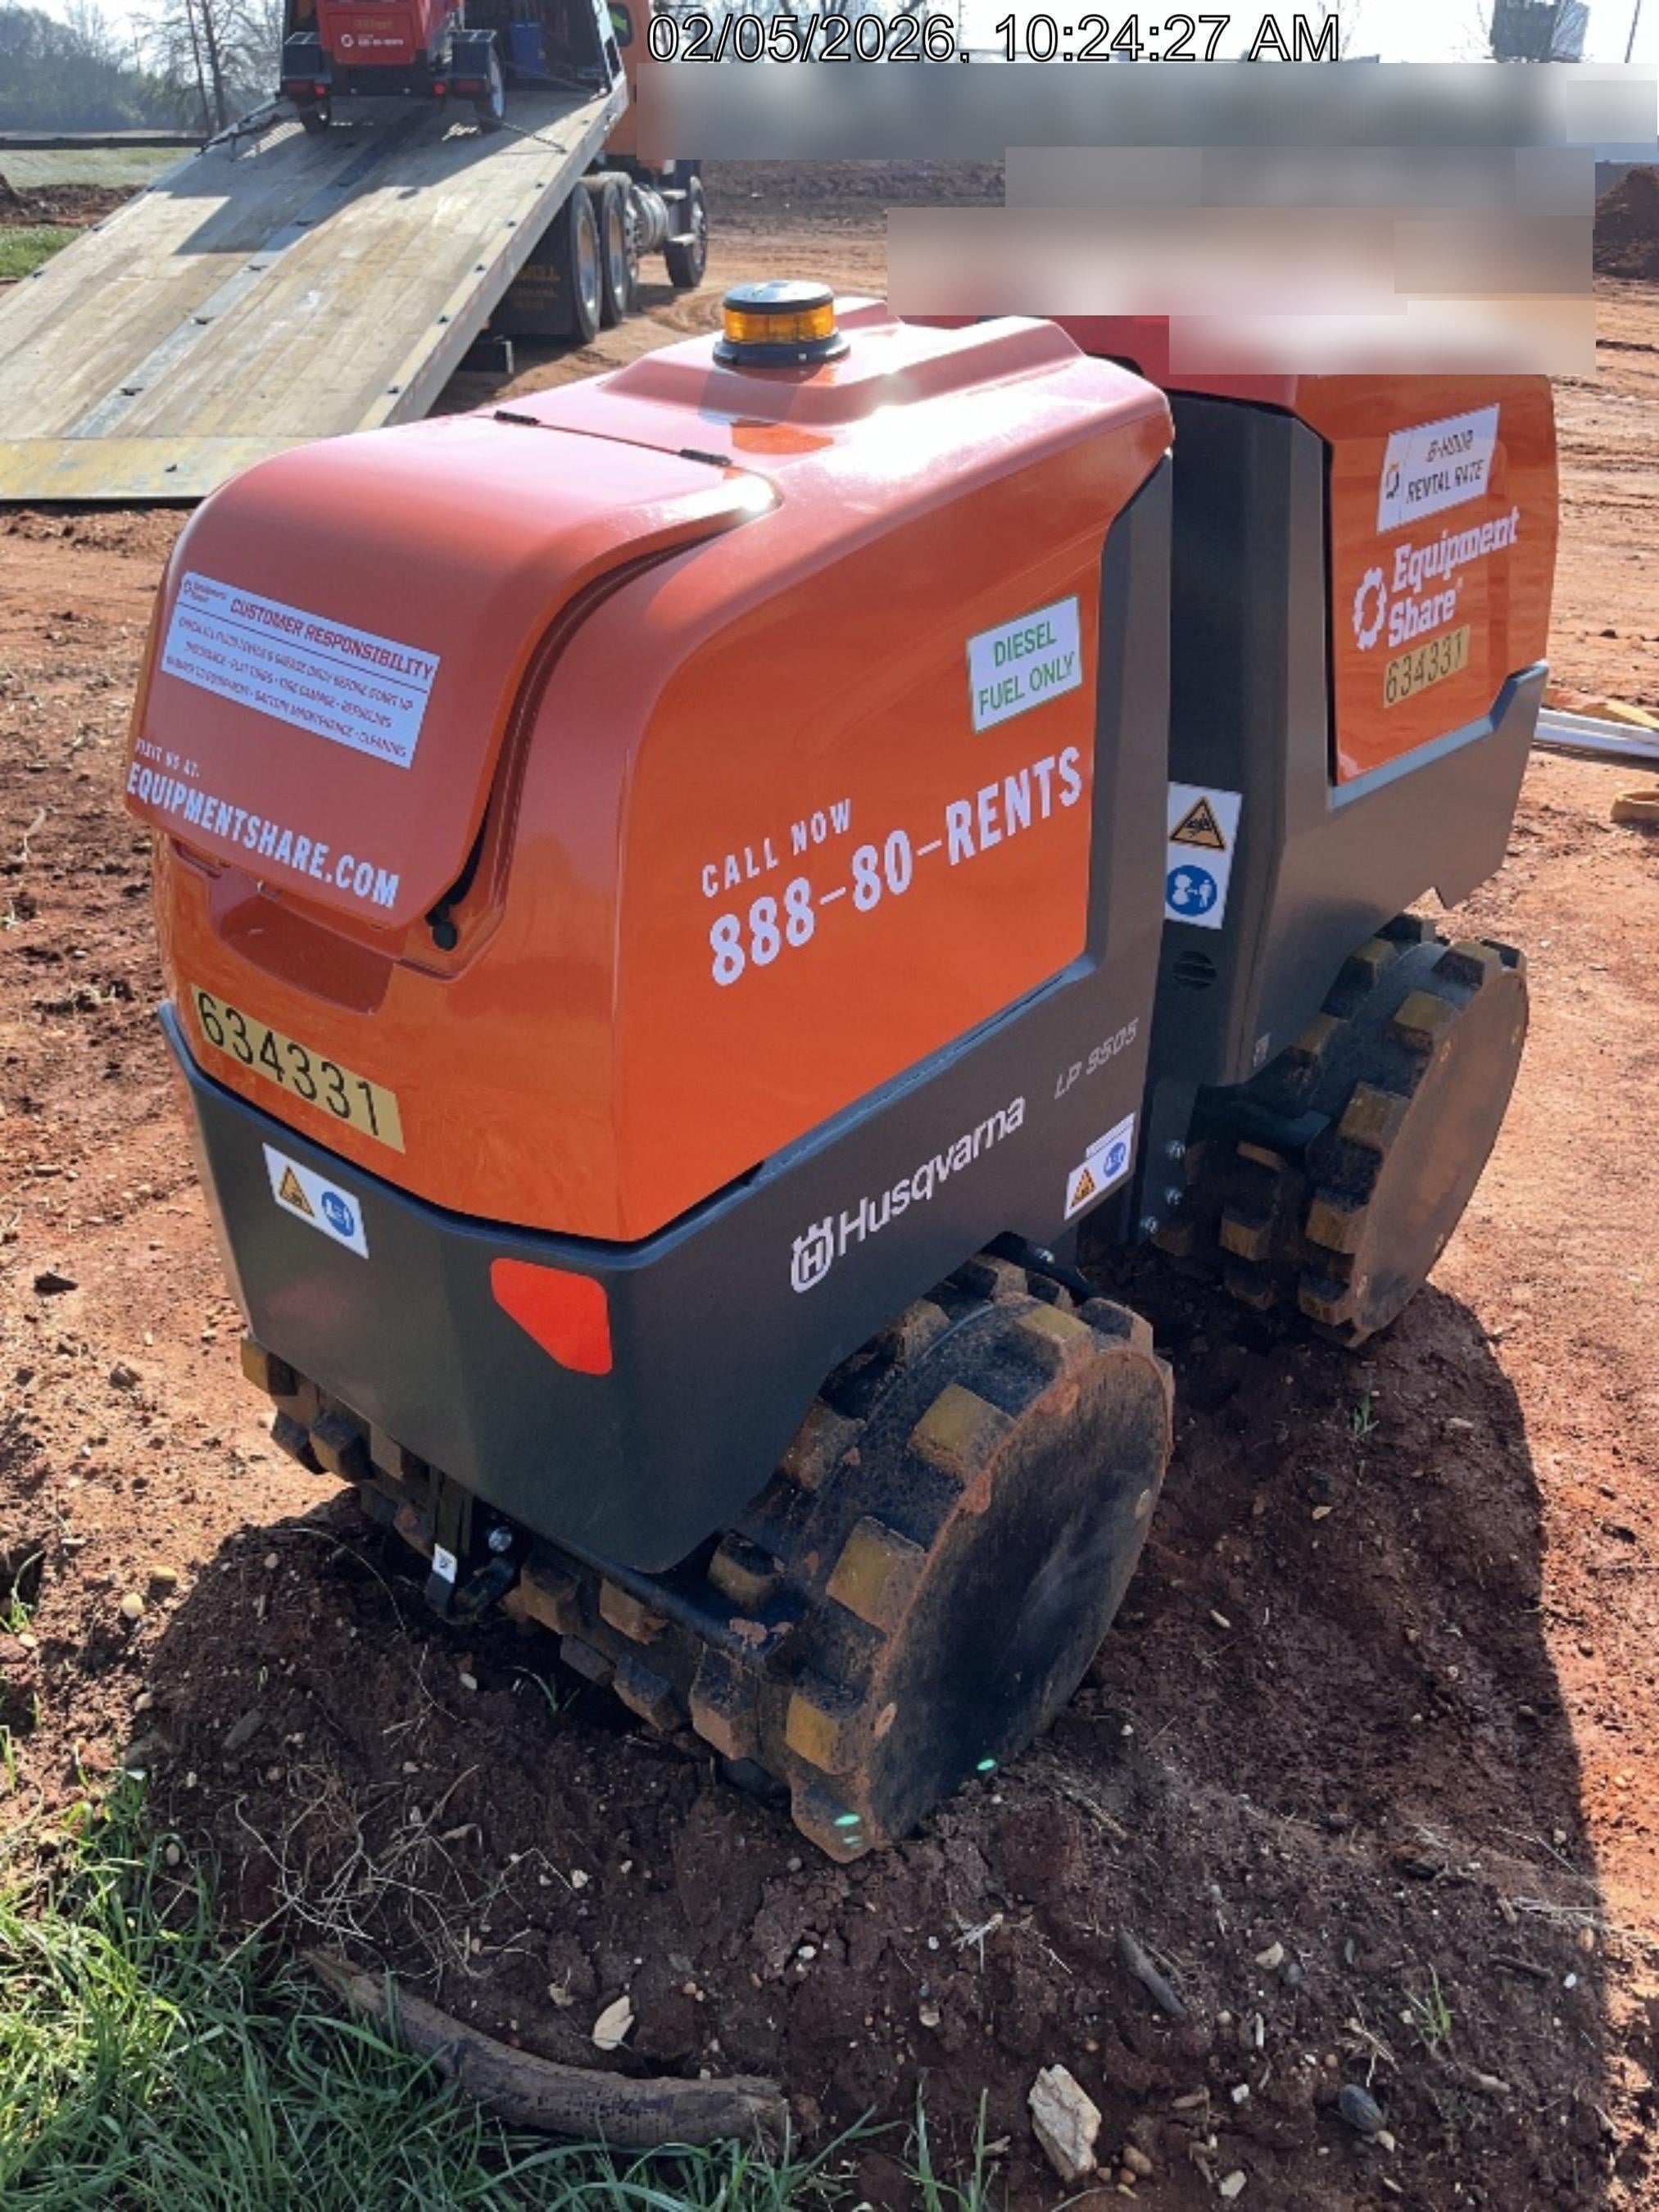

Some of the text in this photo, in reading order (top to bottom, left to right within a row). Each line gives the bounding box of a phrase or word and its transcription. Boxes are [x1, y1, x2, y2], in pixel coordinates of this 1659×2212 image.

[1406, 459, 1485, 505] RENTAL RATE
[1392, 505, 1520, 593] Equipment
[229, 596, 306, 637] CUSTOMER
[305, 624, 433, 682] RESPONSIBILITY
[993, 621, 1058, 668] DIESEL
[1385, 633, 1464, 705] 634331
[978, 650, 1076, 716] FUEL ONLY
[126, 761, 400, 909] EQUIPMENTSHARE.COM
[701, 798, 851, 898] CALL NOW
[709, 746, 1083, 986] 888-80-RENTS
[198, 992, 379, 1136] 634331
[1054, 1017, 1140, 1099] LP 9505
[840, 1096, 1026, 1255] Husqvarna
